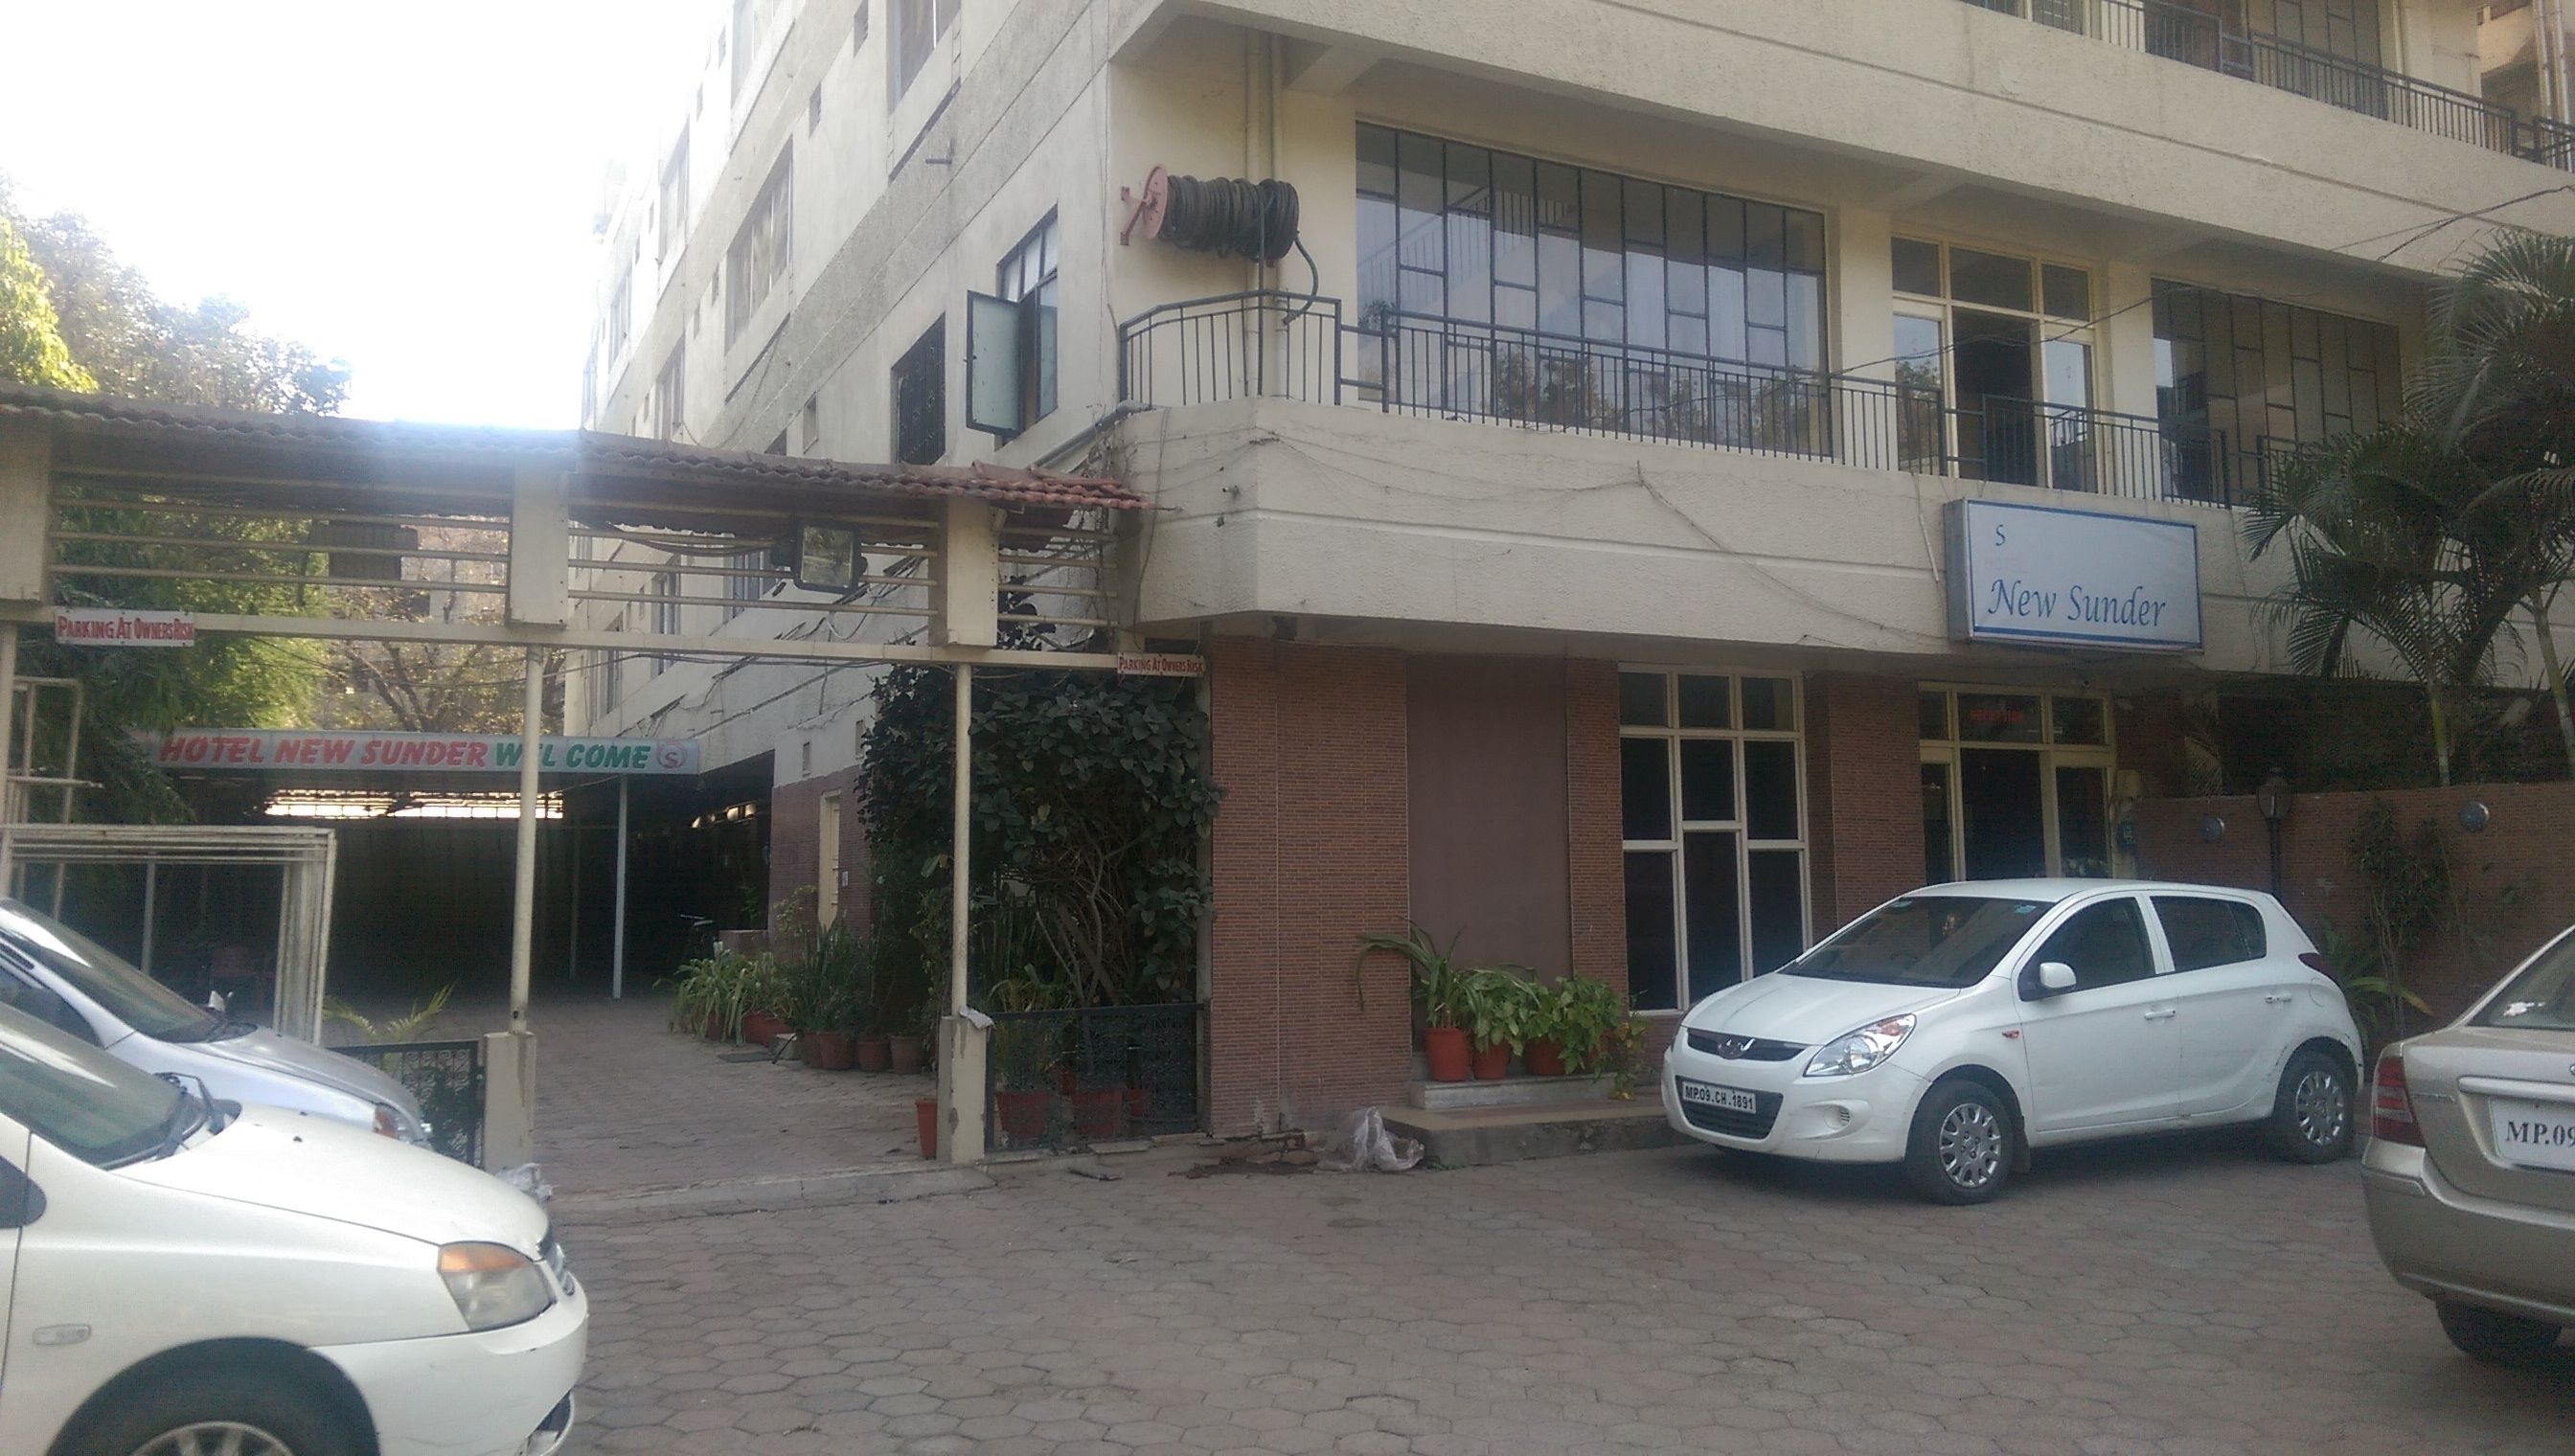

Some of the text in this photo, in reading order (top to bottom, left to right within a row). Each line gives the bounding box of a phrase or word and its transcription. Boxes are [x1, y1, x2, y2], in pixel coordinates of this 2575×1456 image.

[1987, 578, 2167, 627] New Sunder
[57, 615, 114, 639] PARKING
[116, 616, 132, 639] AT
[134, 617, 173, 640] OWNERS
[1119, 656, 1151, 671] PARKING
[1152, 657, 1161, 671] AT
[158, 736, 265, 763] HOTEL
[273, 739, 356, 765] NEW
[360, 739, 490, 767] SUNDER
